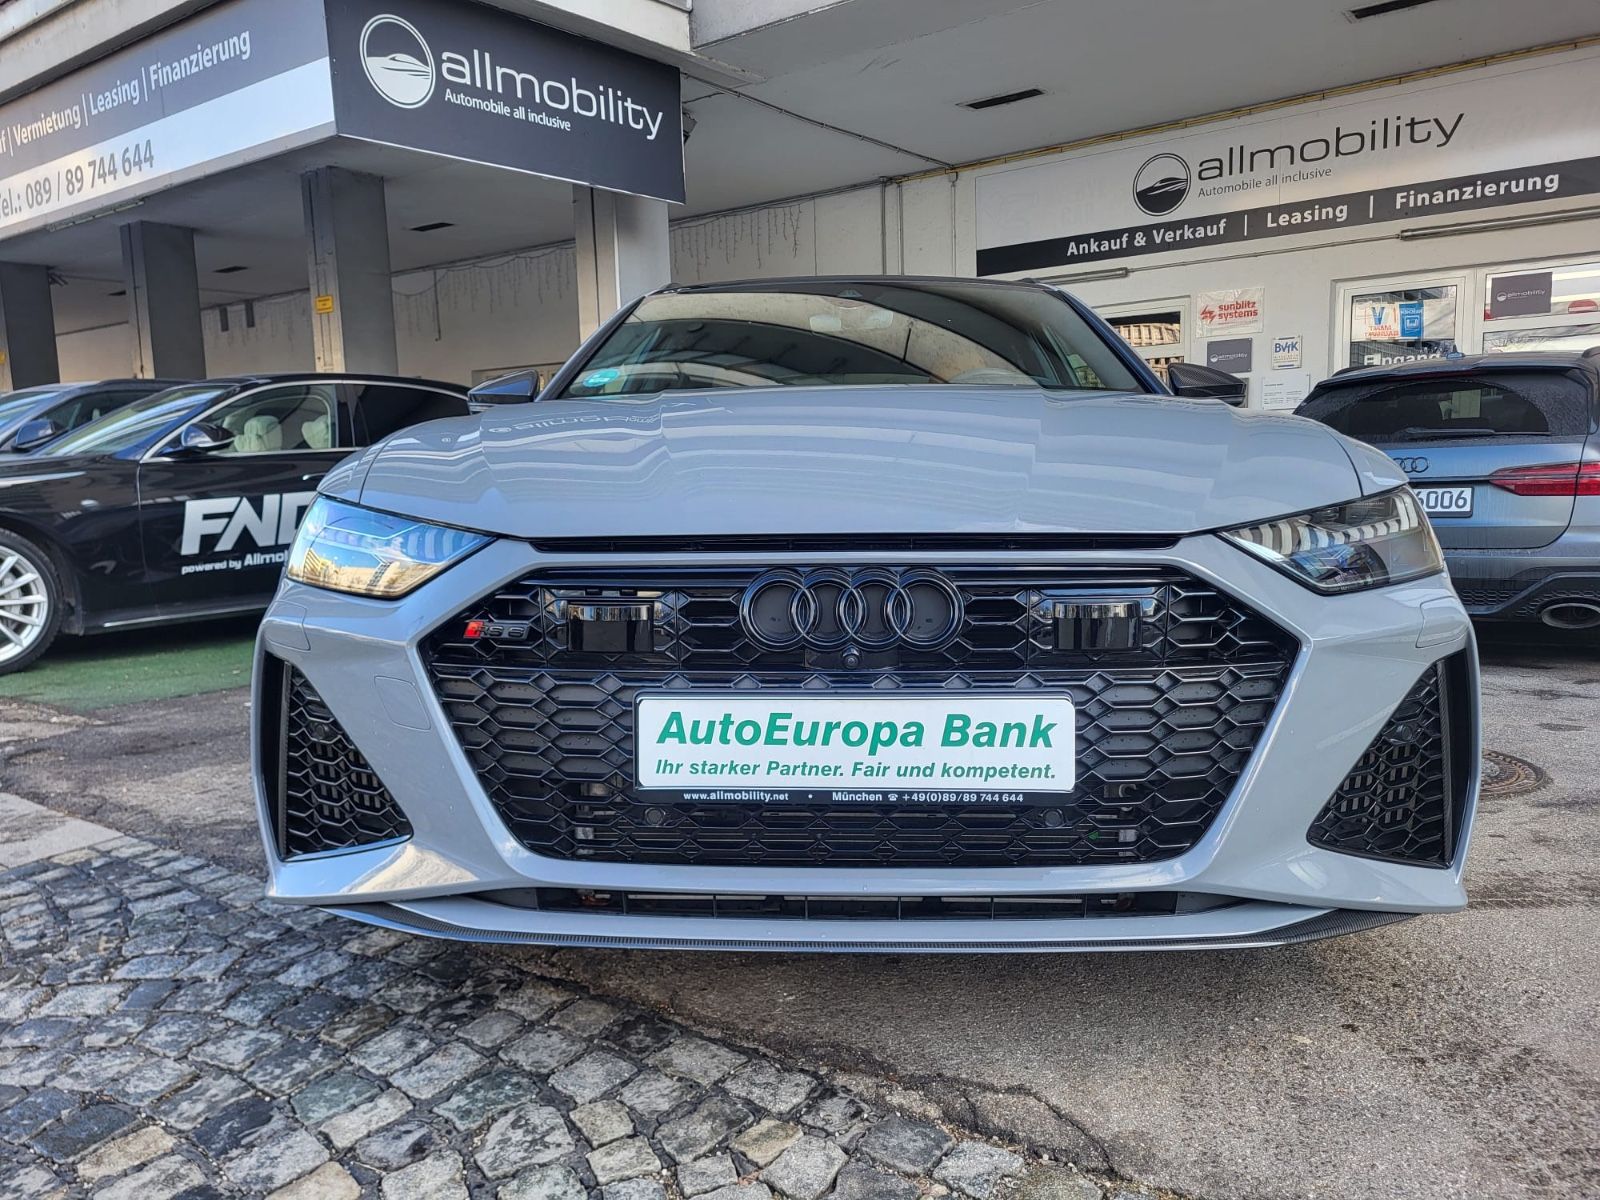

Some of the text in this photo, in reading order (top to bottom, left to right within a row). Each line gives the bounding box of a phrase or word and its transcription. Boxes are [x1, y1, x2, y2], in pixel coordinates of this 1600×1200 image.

[13, 102, 81, 147] Vermietung
[89, 79, 140, 116] Leasing
[149, 30, 250, 90] Finanzierung
[441, 48, 664, 140] allmobility
[445, 88, 571, 132] Automobile all inclusive
[1198, 113, 1464, 181] allmobility
[0, 187, 22, 217] el.:
[25, 176, 52, 209] 089
[65, 165, 84, 196] 89
[88, 152, 117, 189] 744
[121, 139, 154, 177] 644
[1198, 167, 1332, 198] Automobile all inclusive
[1067, 233, 1129, 256] Ankauf
[1133, 231, 1147, 247] &
[1153, 219, 1226, 244] Verkauf
[1267, 203, 1348, 228] Leasing
[1395, 173, 1560, 209] Finanzierung
[1218, 300, 1256, 311] sunblitz
[1218, 309, 1258, 321] systems
[181, 560, 228, 575] powered
[229, 558, 242, 570] by
[656, 711, 1058, 756] AutoEuropa Bank
[655, 759, 1056, 782] Ihr starker Partner. Fair und kompetent.
[683, 790, 1023, 803] www.allmobility.net München +49(0)89/89 744 644
